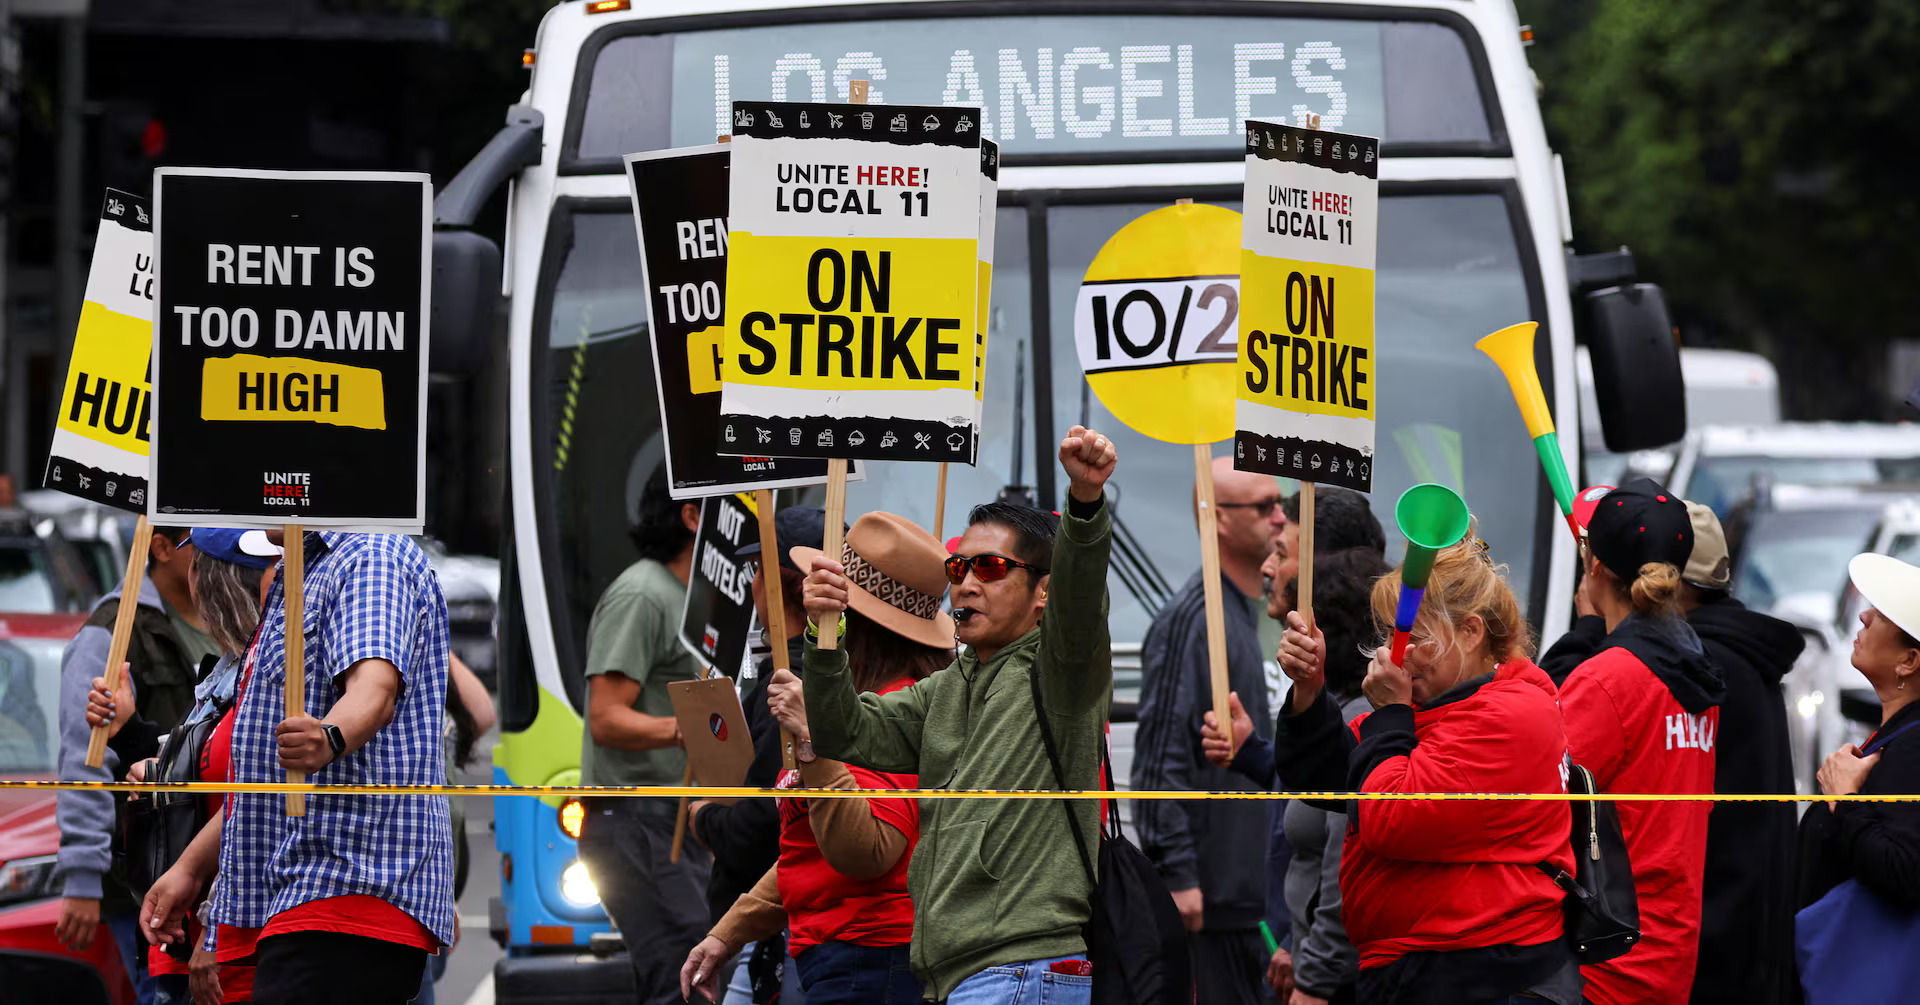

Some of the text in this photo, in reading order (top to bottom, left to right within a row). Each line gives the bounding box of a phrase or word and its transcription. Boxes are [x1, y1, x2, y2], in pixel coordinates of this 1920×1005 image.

[942, 41, 1348, 141] ANGELES
[777, 163, 930, 188] UNITE HERE!
[776, 187, 929, 217] LOCAL 11
[1268, 184, 1353, 217] UNITE HERE!
[677, 216, 730, 260] REN
[1267, 209, 1353, 245] LOCAL 11
[207, 244, 375, 288] RENT IS
[806, 248, 892, 314] ON
[660, 281, 721, 324] TOO
[1285, 271, 1334, 339] ON
[174, 305, 405, 351] TOO DAMN
[738, 311, 961, 381] STRIKE
[1245, 330, 1368, 411] STRIKE
[238, 371, 340, 414] HIGH
[263, 472, 311, 485] UNITE
[743, 461, 776, 472] LOCAL 11
[263, 485, 309, 498] HERE!
[263, 497, 310, 506] LOCAL 11
[717, 497, 746, 547] NOT
[701, 540, 748, 606] HOTELS
